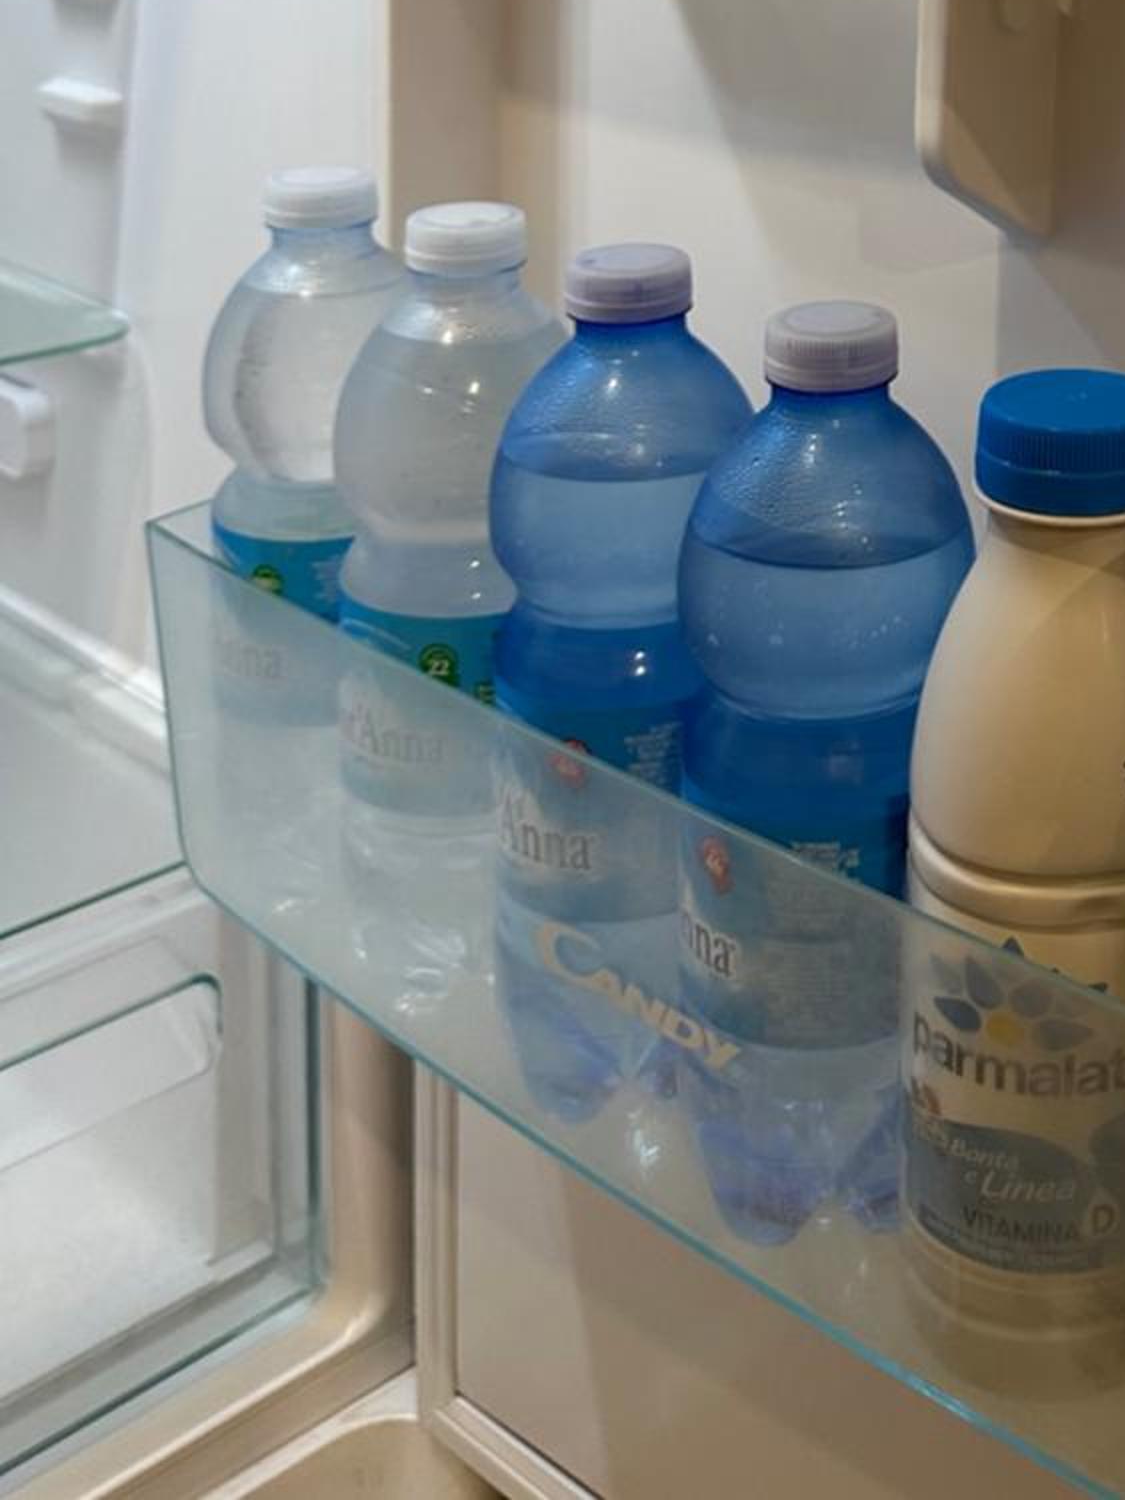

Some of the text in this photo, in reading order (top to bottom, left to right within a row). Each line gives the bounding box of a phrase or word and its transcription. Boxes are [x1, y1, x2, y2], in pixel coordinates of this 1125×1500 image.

[429, 658, 450, 675] 22
[979, 1168, 1077, 1203] Linea
[961, 1203, 1083, 1243] VITAMINA
[1091, 1201, 1116, 1235] D
